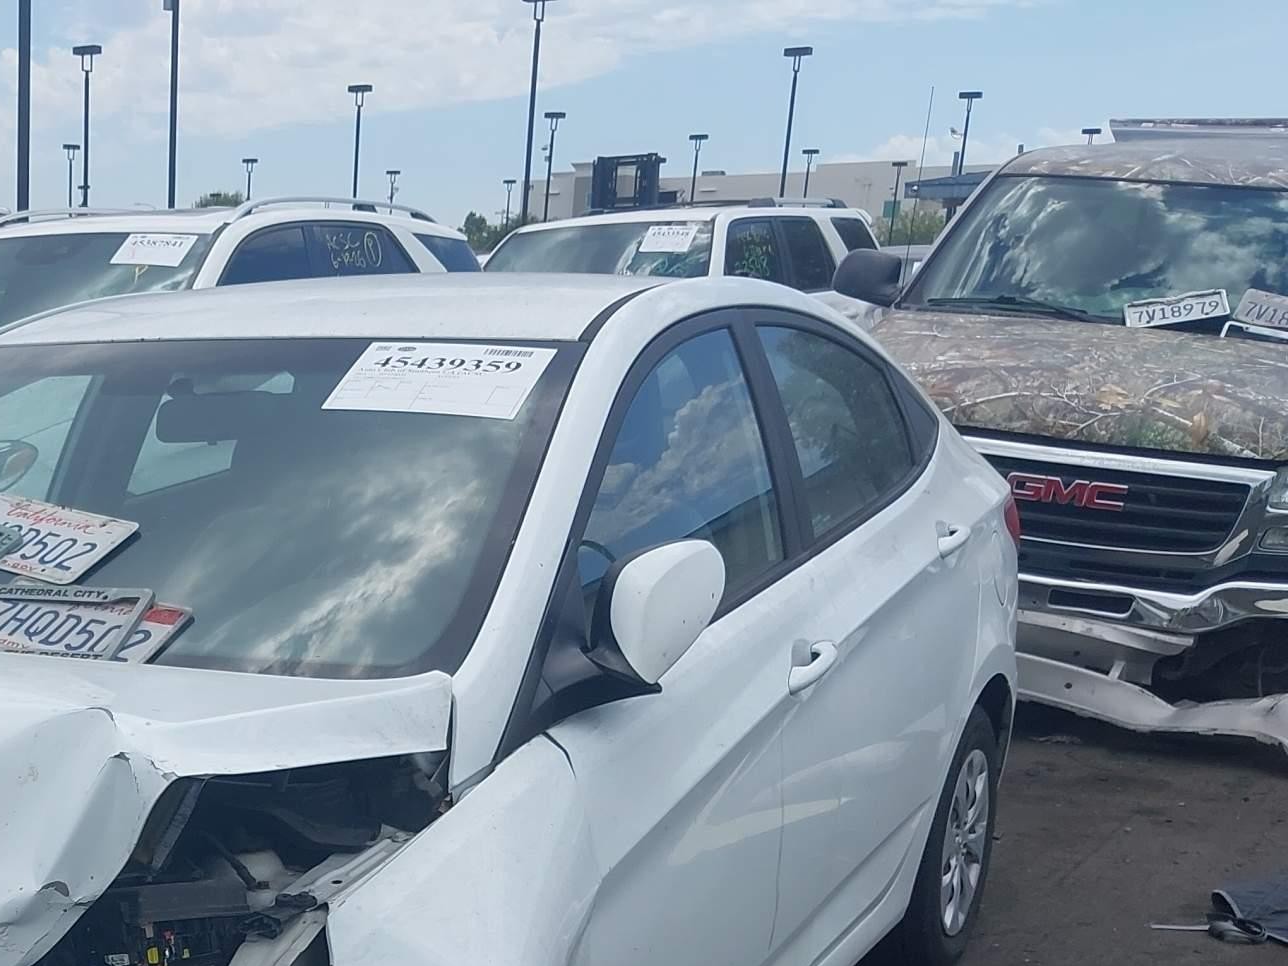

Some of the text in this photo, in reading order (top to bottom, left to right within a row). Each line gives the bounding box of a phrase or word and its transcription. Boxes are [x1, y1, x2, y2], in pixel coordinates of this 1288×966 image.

[1133, 299, 1220, 324] 7V18979
[374, 355, 523, 374] 45439359
[1007, 472, 1129, 512] GMC
[73, 589, 105, 599] CITY
